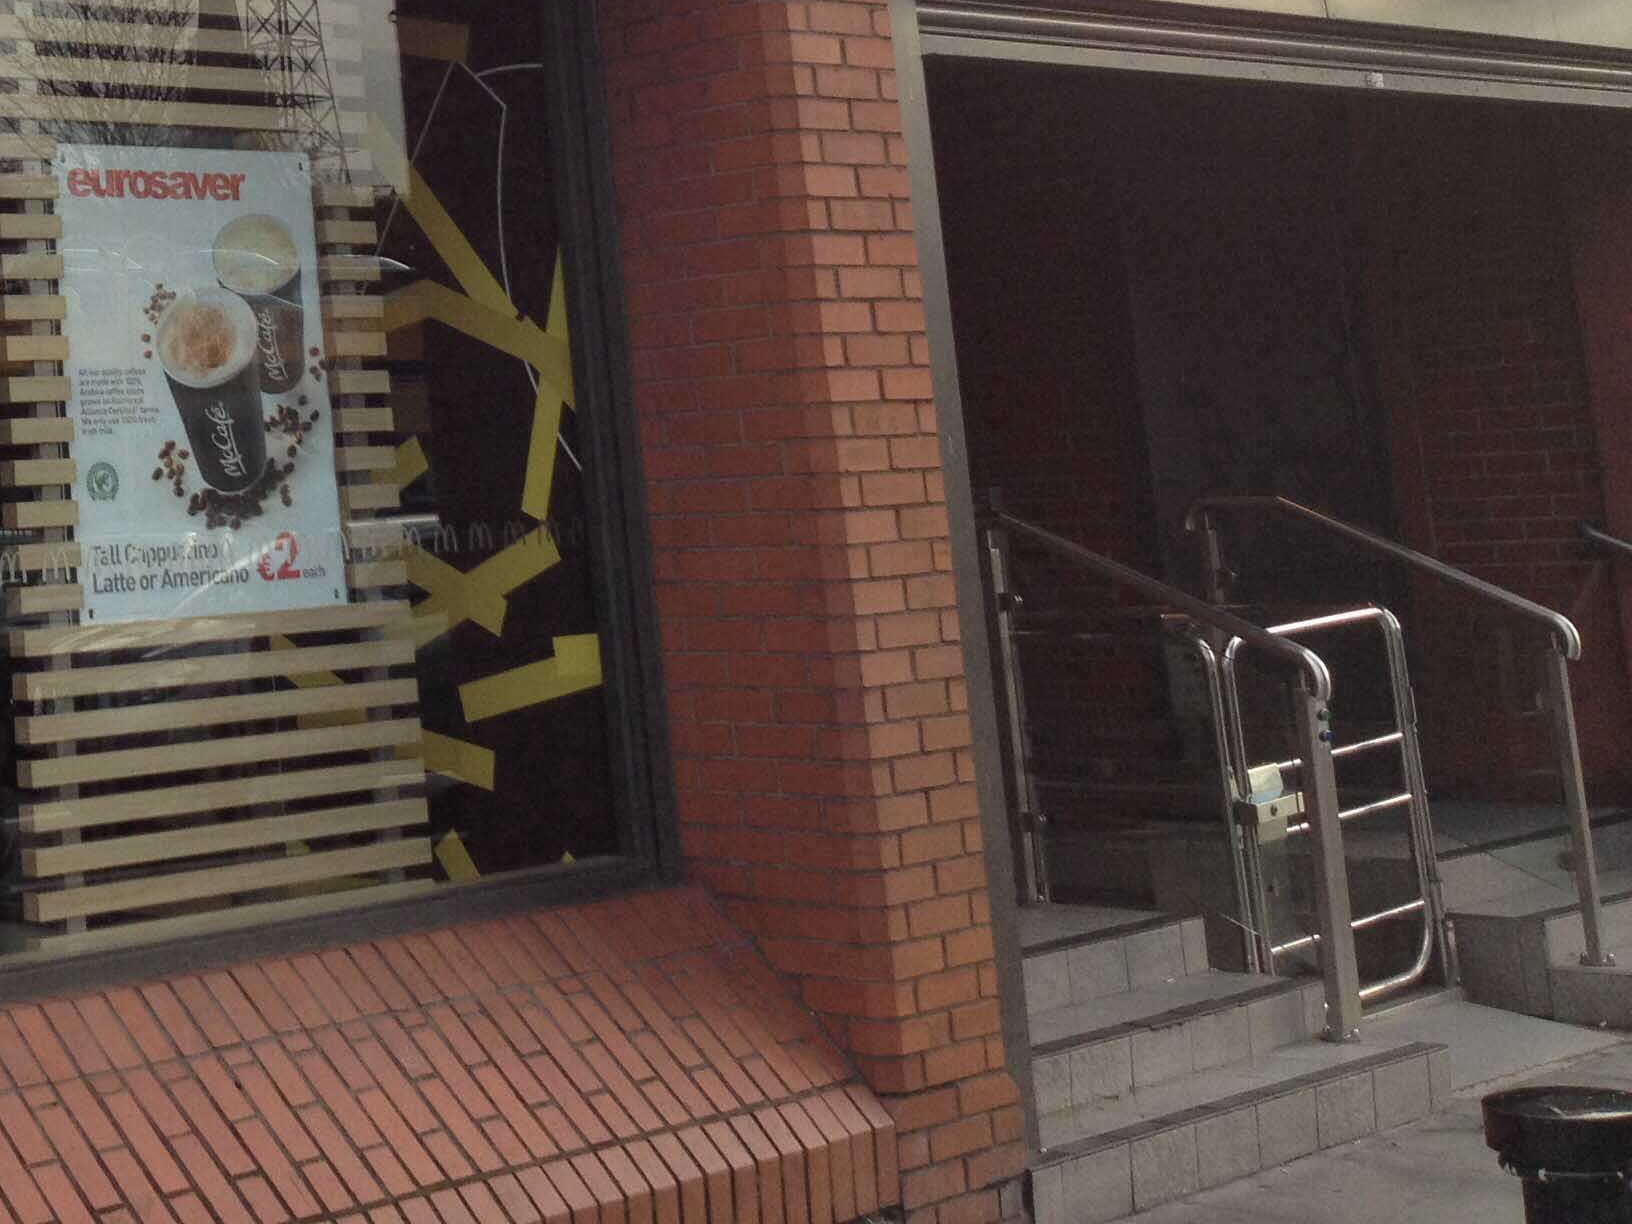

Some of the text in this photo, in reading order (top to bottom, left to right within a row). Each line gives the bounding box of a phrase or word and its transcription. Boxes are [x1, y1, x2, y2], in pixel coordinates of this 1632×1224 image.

[68, 168, 247, 201] eurosaver
[125, 540, 218, 569] Cappuino
[93, 567, 250, 594] Latte or Americano
